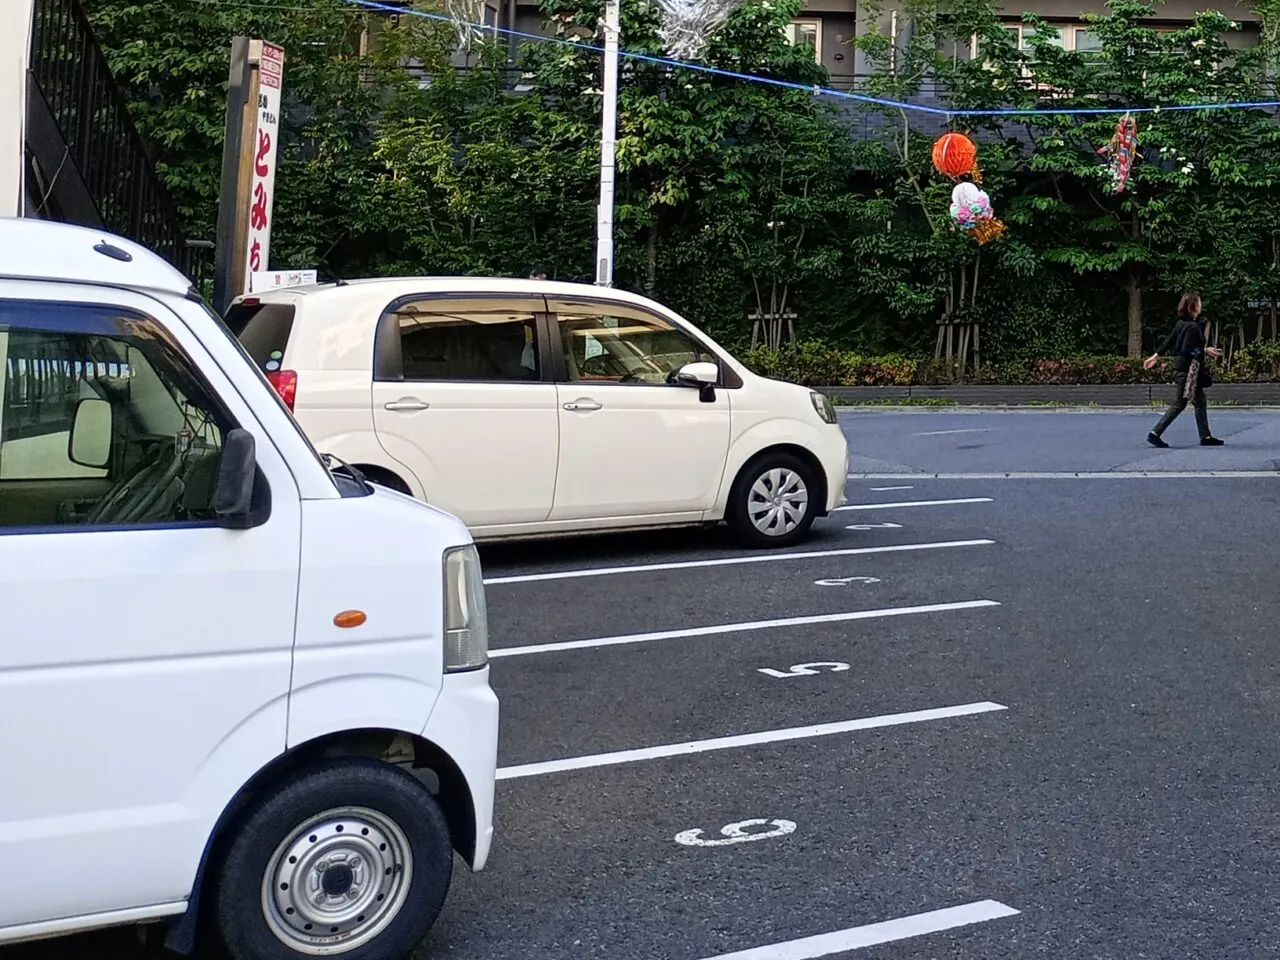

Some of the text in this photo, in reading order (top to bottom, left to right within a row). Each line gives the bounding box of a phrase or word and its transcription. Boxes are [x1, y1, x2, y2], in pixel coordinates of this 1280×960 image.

[844, 522, 903, 530] 2
[814, 576, 881, 586] 3
[757, 661, 851, 679] 5
[674, 818, 797, 847] 6
